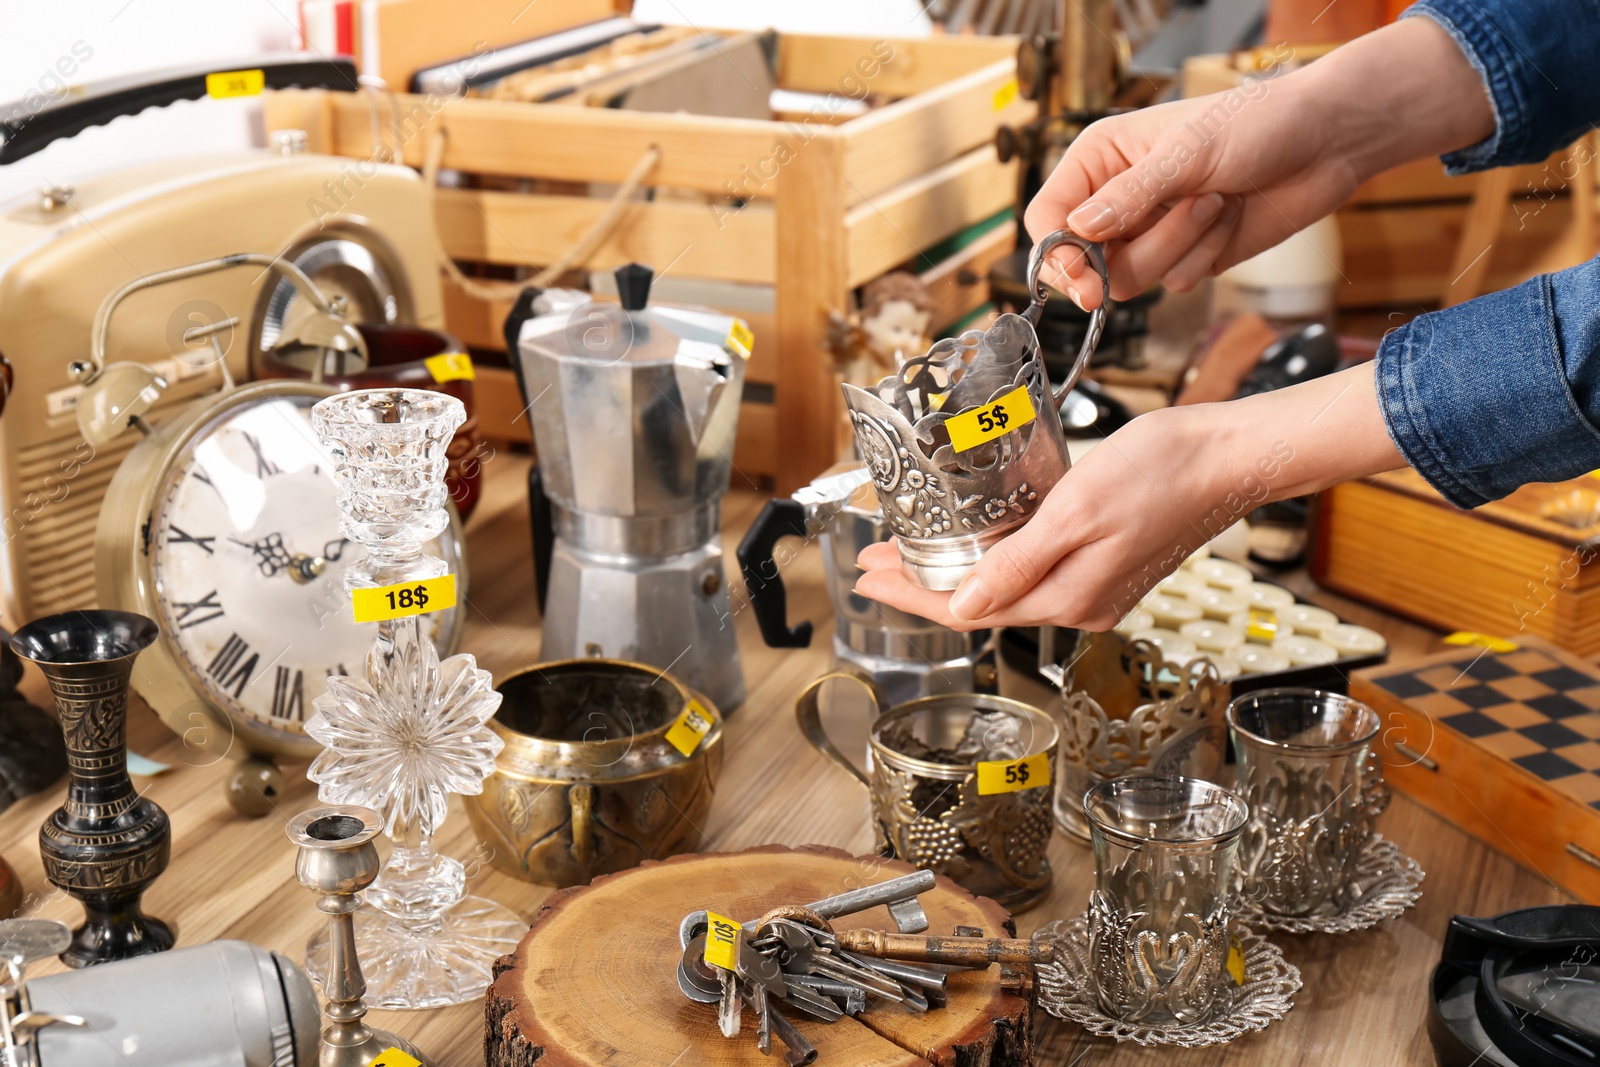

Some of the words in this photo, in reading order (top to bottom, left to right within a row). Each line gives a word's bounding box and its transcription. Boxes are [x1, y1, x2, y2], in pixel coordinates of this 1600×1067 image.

[977, 405, 1009, 433] 5$
[385, 584, 429, 611] 18$
[1005, 762, 1030, 786] 5$
[714, 920, 738, 945] 10$
